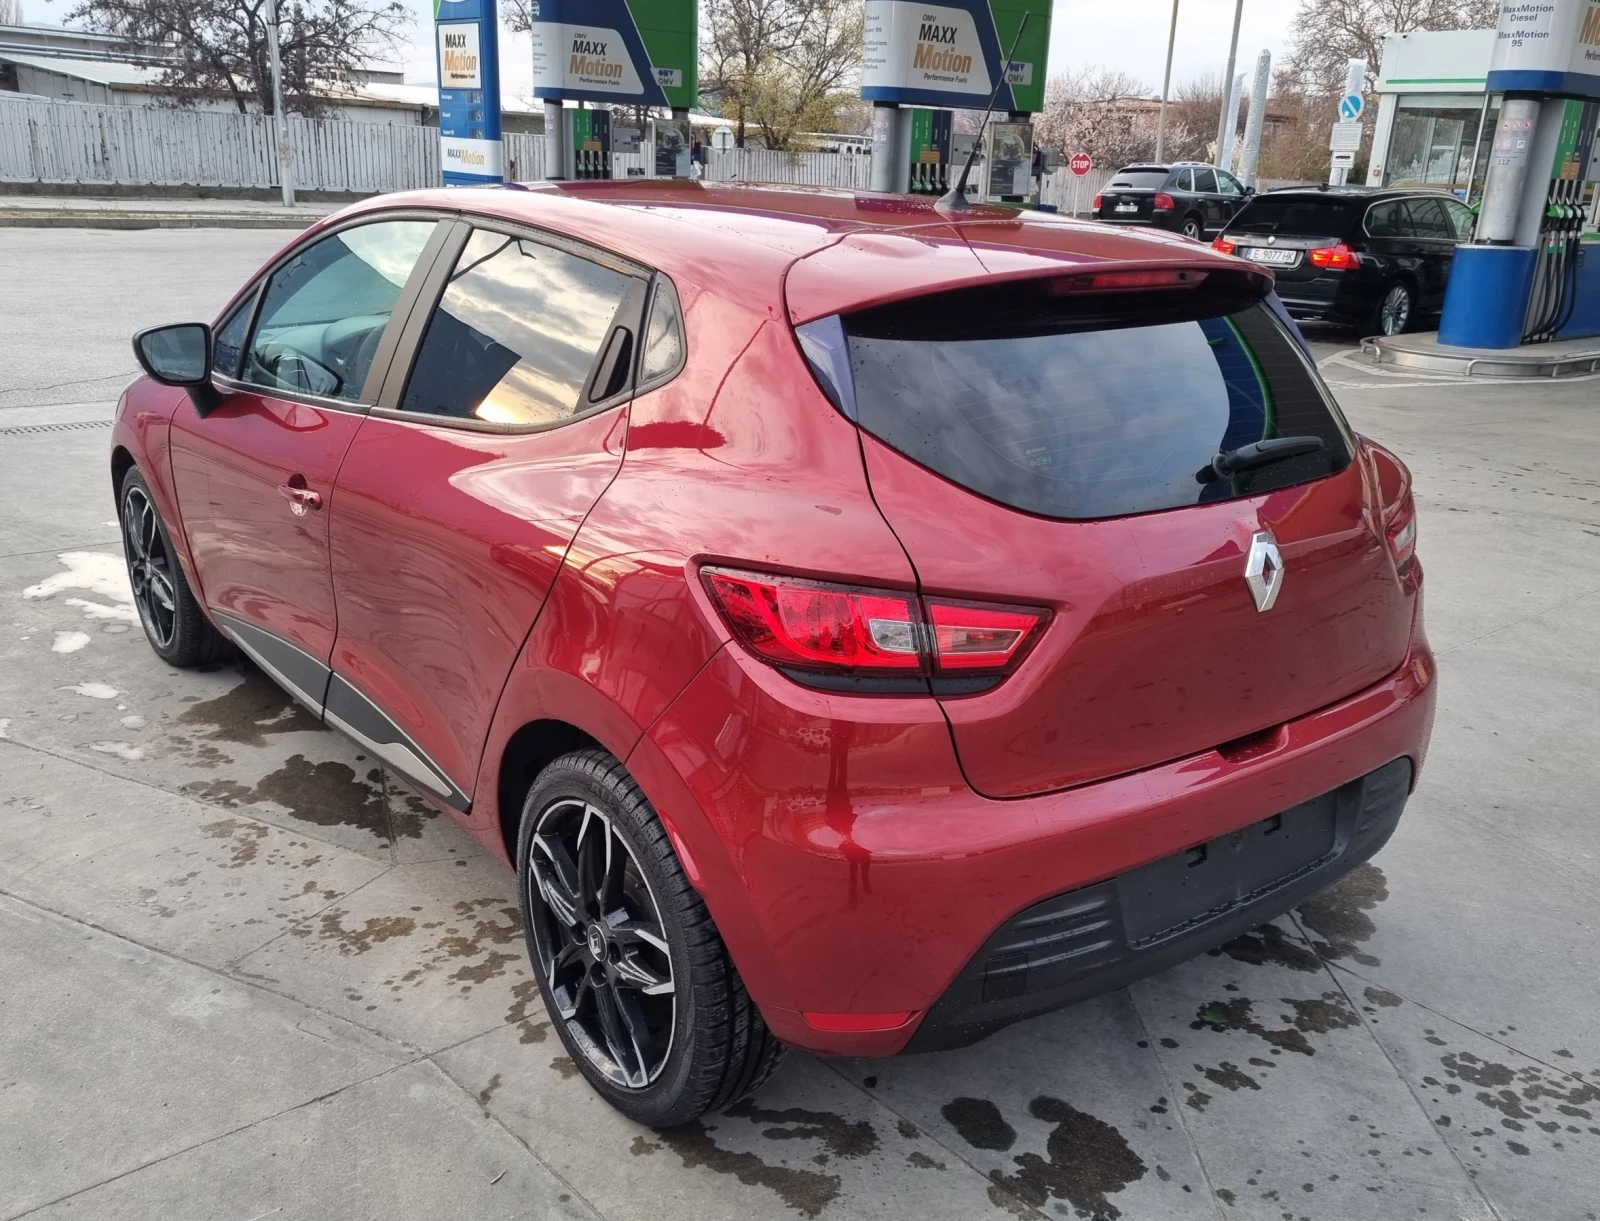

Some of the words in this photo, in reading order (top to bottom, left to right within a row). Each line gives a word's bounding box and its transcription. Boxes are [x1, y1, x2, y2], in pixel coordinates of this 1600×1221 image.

[1503, 4, 1554, 14] MaxxMotion
[922, 14, 936, 22] OMV
[1510, 13, 1538, 22] Diesel
[919, 23, 957, 44] MAXX
[1498, 30, 1549, 39] MaxxMotion
[445, 33, 466, 48] MAXX
[1511, 39, 1523, 47] 95
[572, 40, 607, 56] MAXX
[444, 49, 477, 71] Motion
[913, 43, 972, 74] Motion
[569, 54, 623, 78] Motion
[579, 77, 607, 85] Performance
[924, 73, 954, 83] Performance
[955, 76, 968, 84] Fuels
[1008, 74, 1025, 83] OMV
[1072, 160, 1090, 169] STOP
[1254, 249, 1260, 259] E
[1263, 250, 1282, 260] 9077
[1282, 251, 1295, 262] HK
